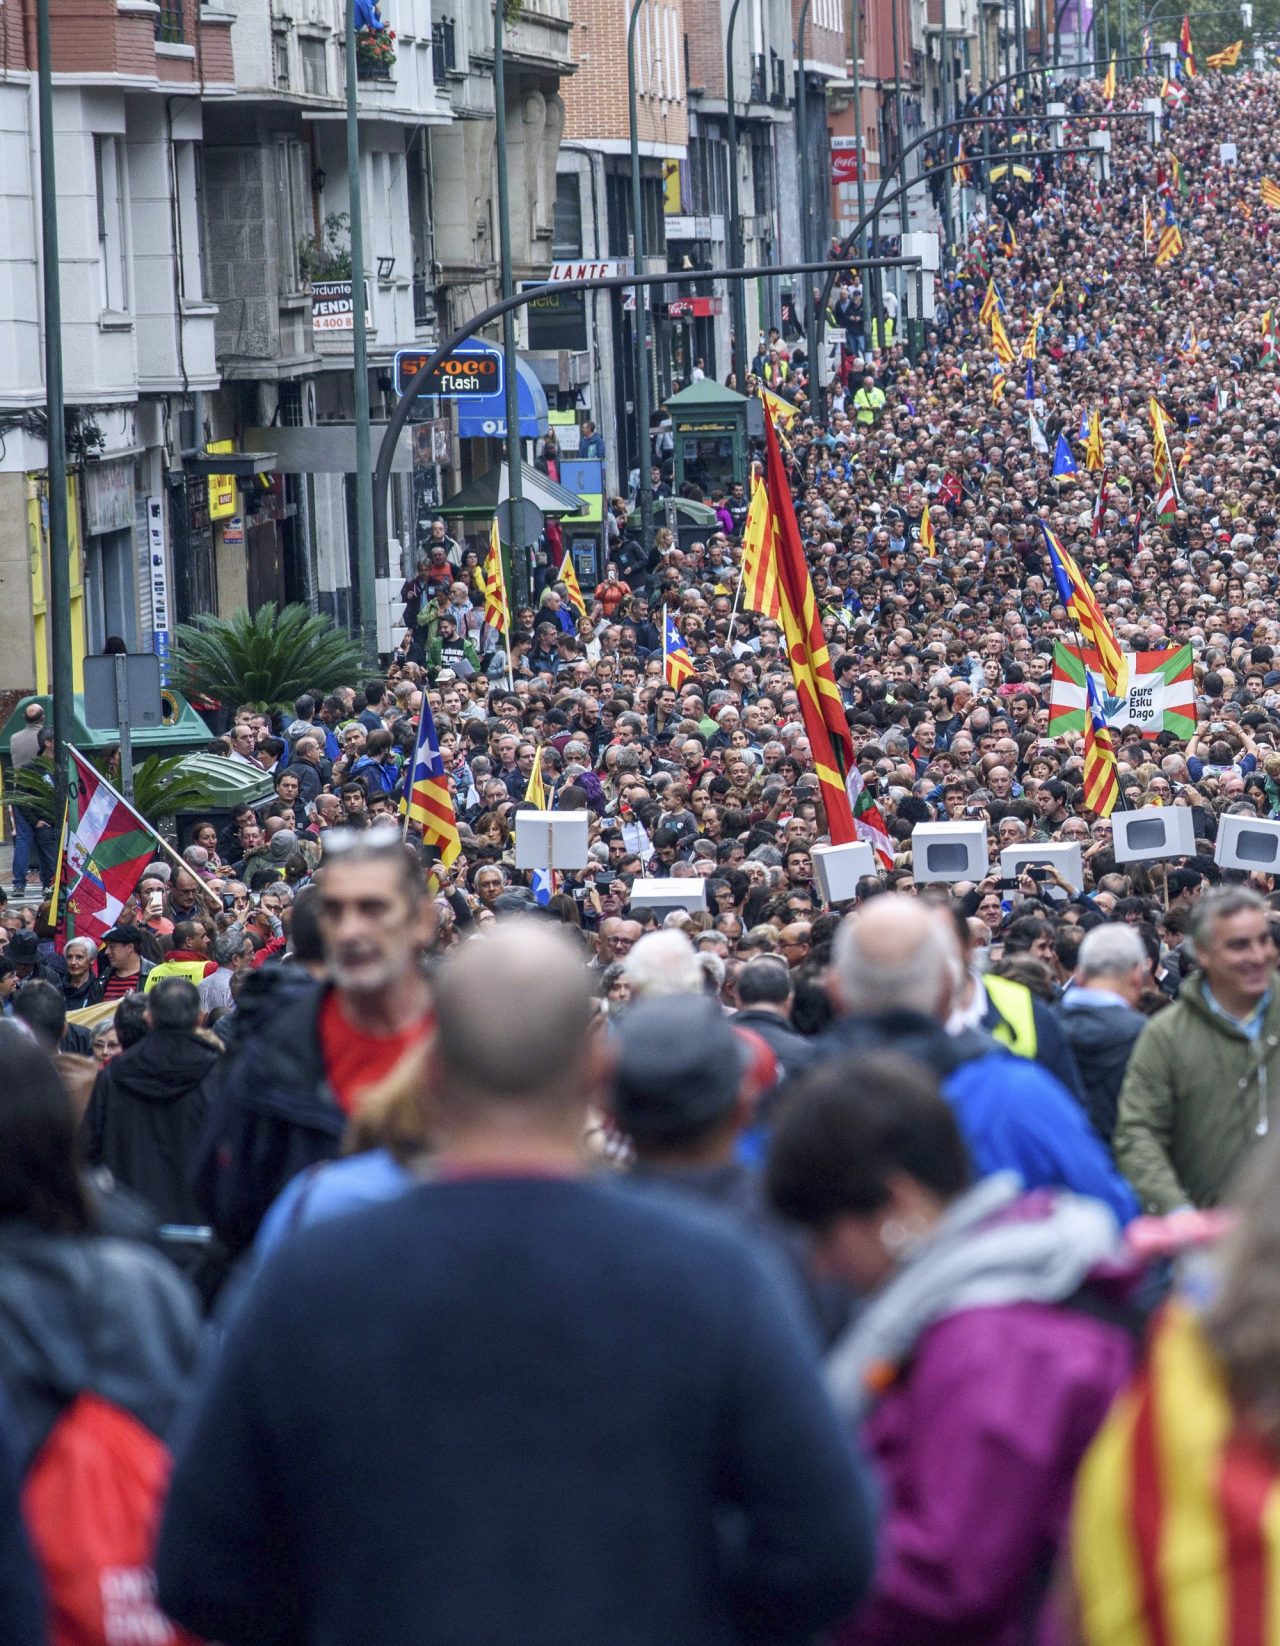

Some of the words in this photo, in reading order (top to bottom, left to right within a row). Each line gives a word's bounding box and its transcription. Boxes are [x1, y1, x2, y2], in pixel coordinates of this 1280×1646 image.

[552, 264, 609, 280] LANTE
[323, 318, 343, 328] 400
[440, 375, 480, 392] flash
[482, 420, 508, 435] OL
[1129, 686, 1153, 697] Gure
[1129, 697, 1152, 708] Esku
[1129, 708, 1154, 722] Dago
